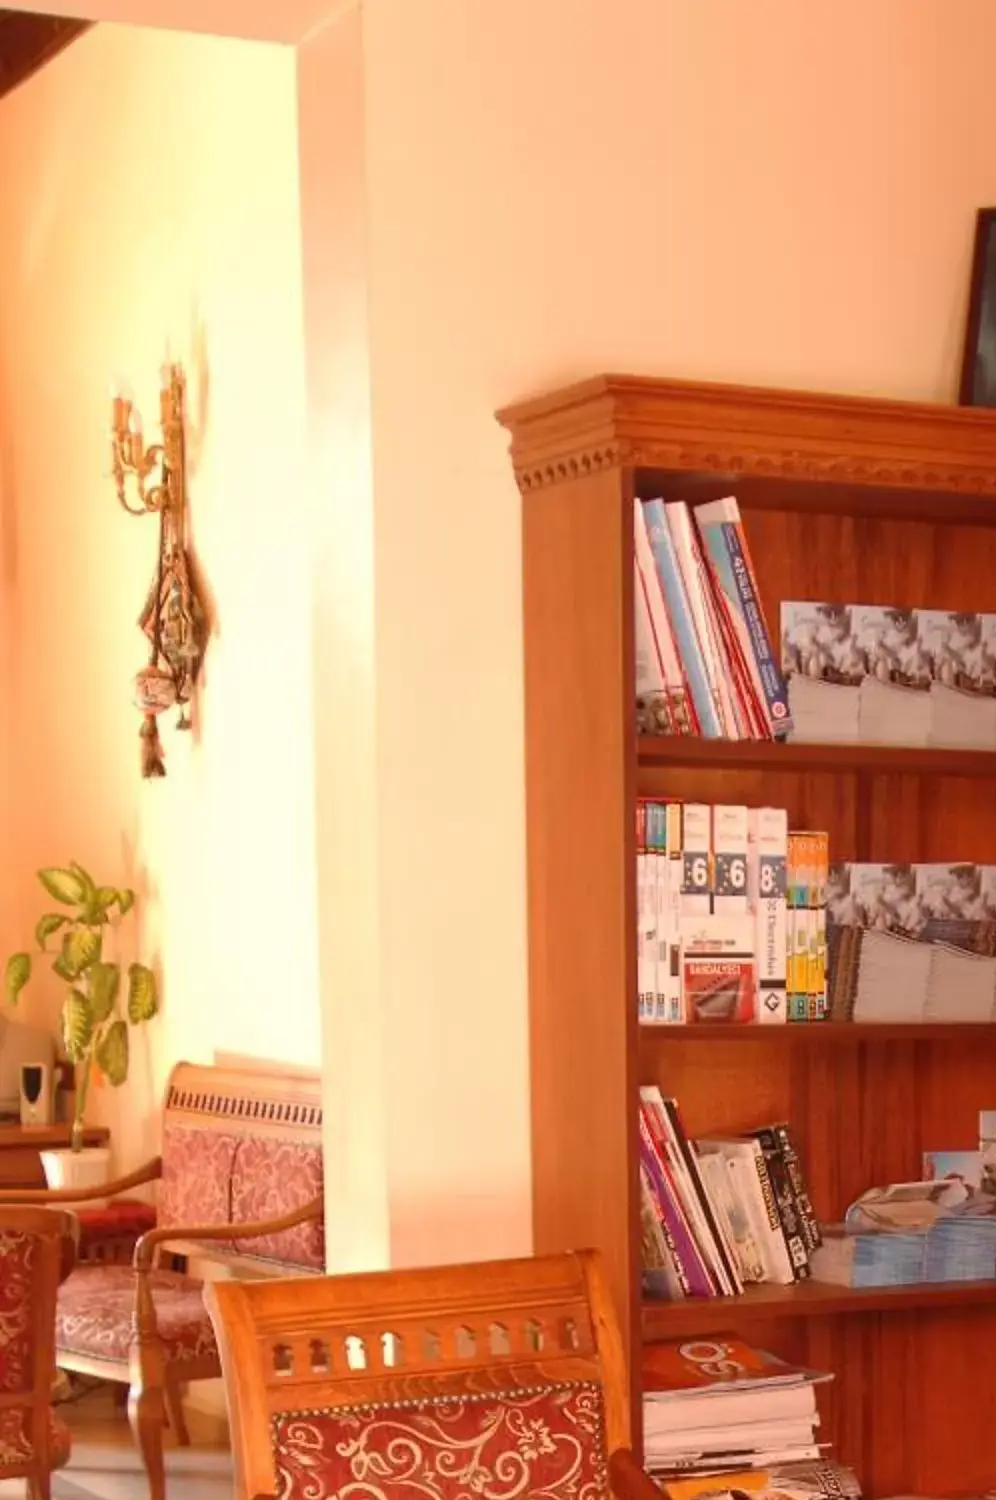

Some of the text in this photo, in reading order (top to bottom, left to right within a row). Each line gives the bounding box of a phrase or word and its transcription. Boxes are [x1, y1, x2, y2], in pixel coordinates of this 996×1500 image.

[692, 857, 708, 887] 6
[730, 858, 745, 888] 6
[761, 863, 773, 893] 8
